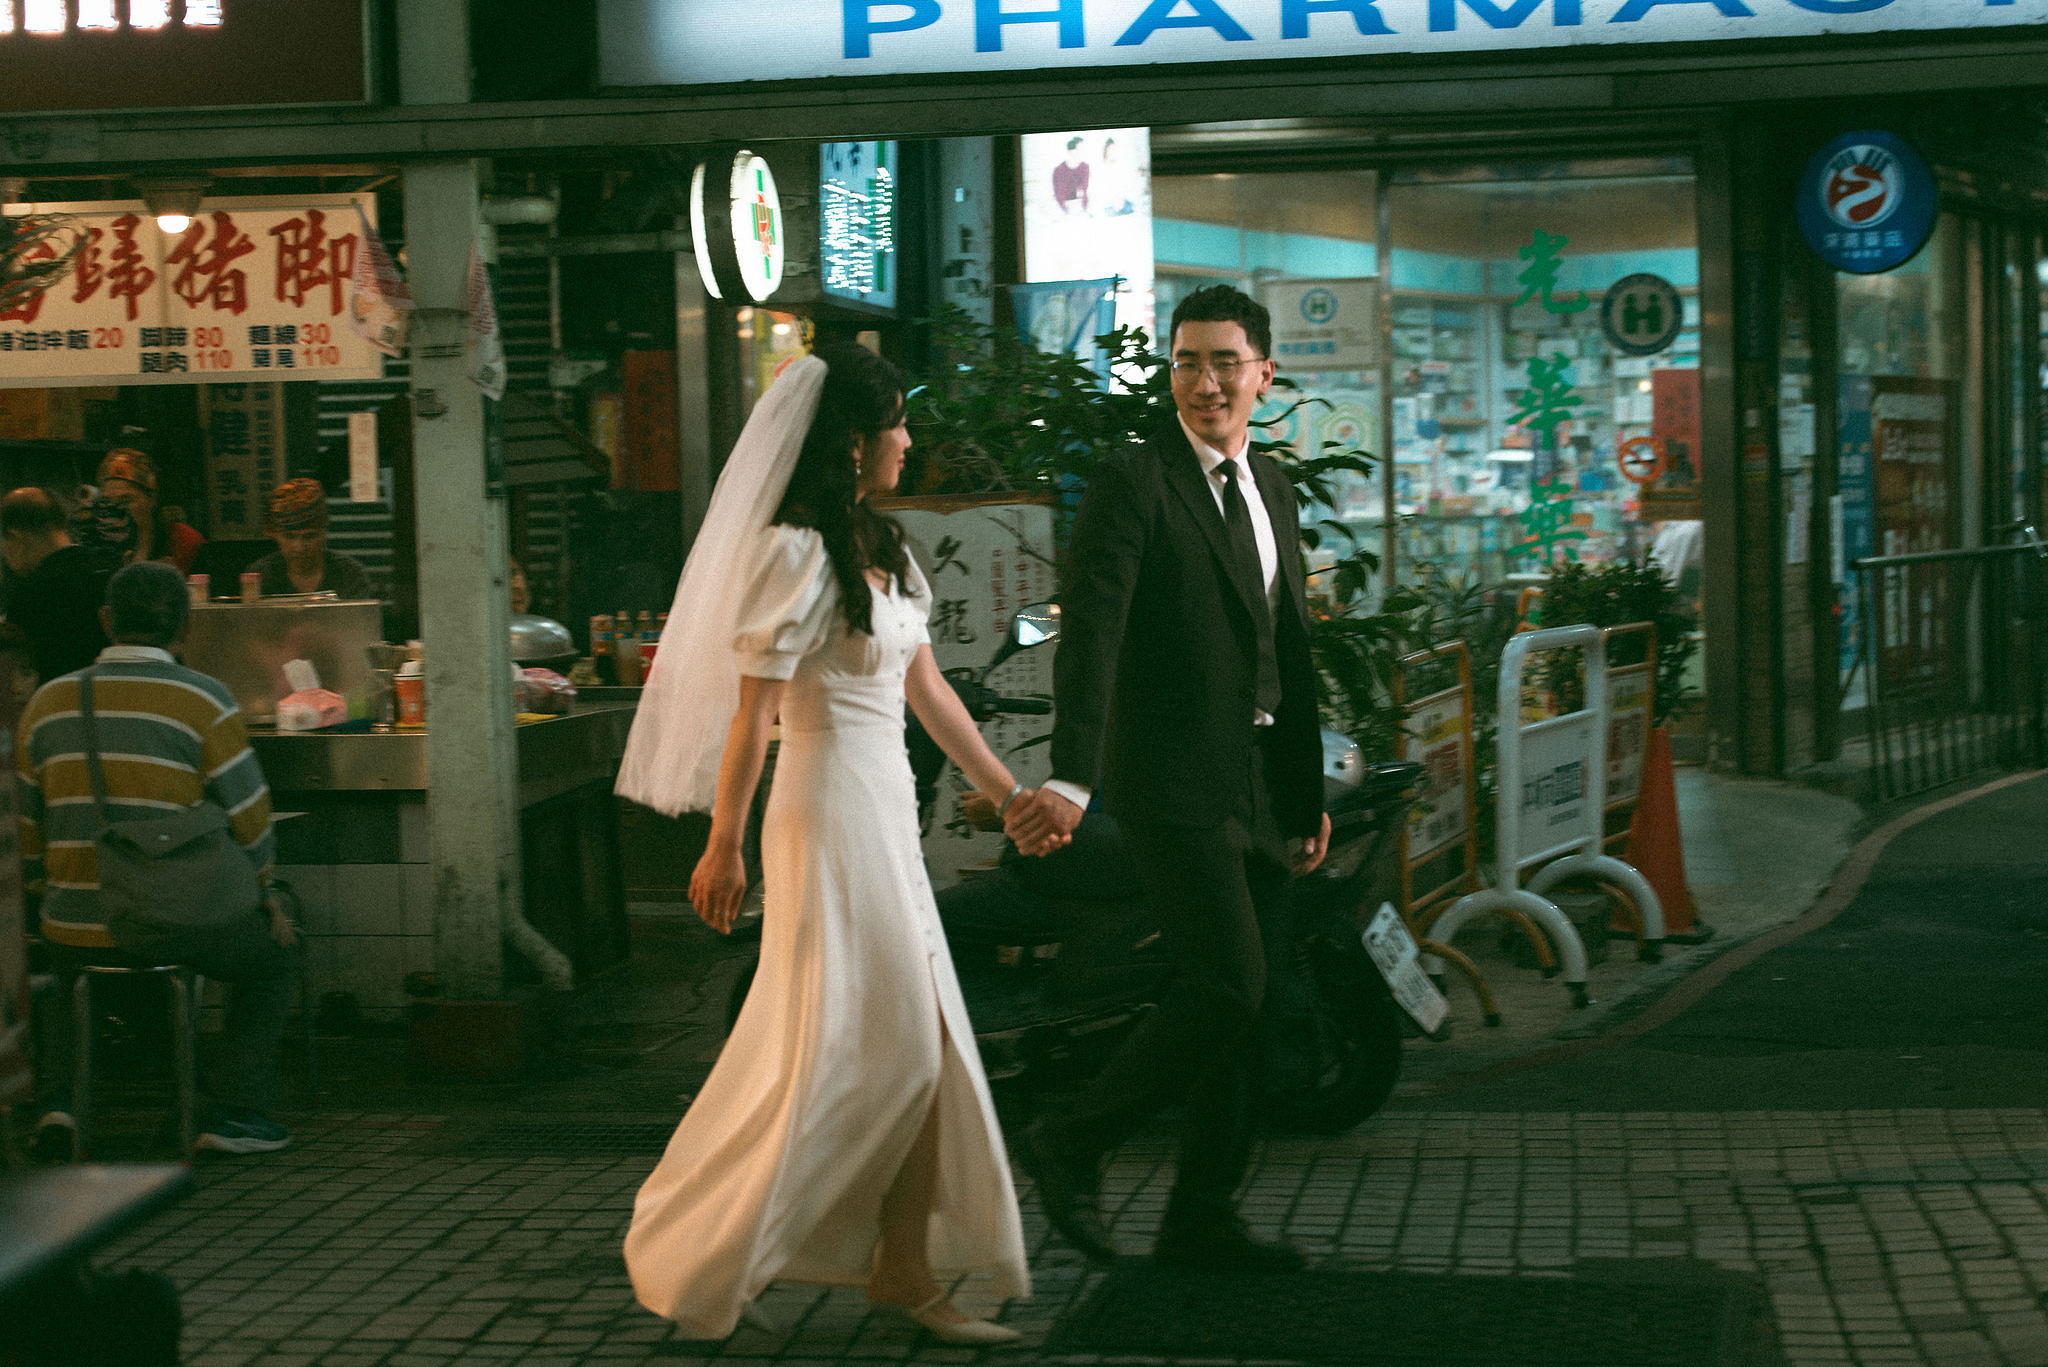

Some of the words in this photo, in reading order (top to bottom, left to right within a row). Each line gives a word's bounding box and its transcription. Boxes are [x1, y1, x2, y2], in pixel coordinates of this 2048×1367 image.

[844, 0, 2014, 59] PHARM
[94, 326, 125, 349] 20
[194, 325, 225, 348] 80
[300, 322, 332, 345] 30
[195, 349, 233, 370] 110
[301, 345, 342, 367] 110
